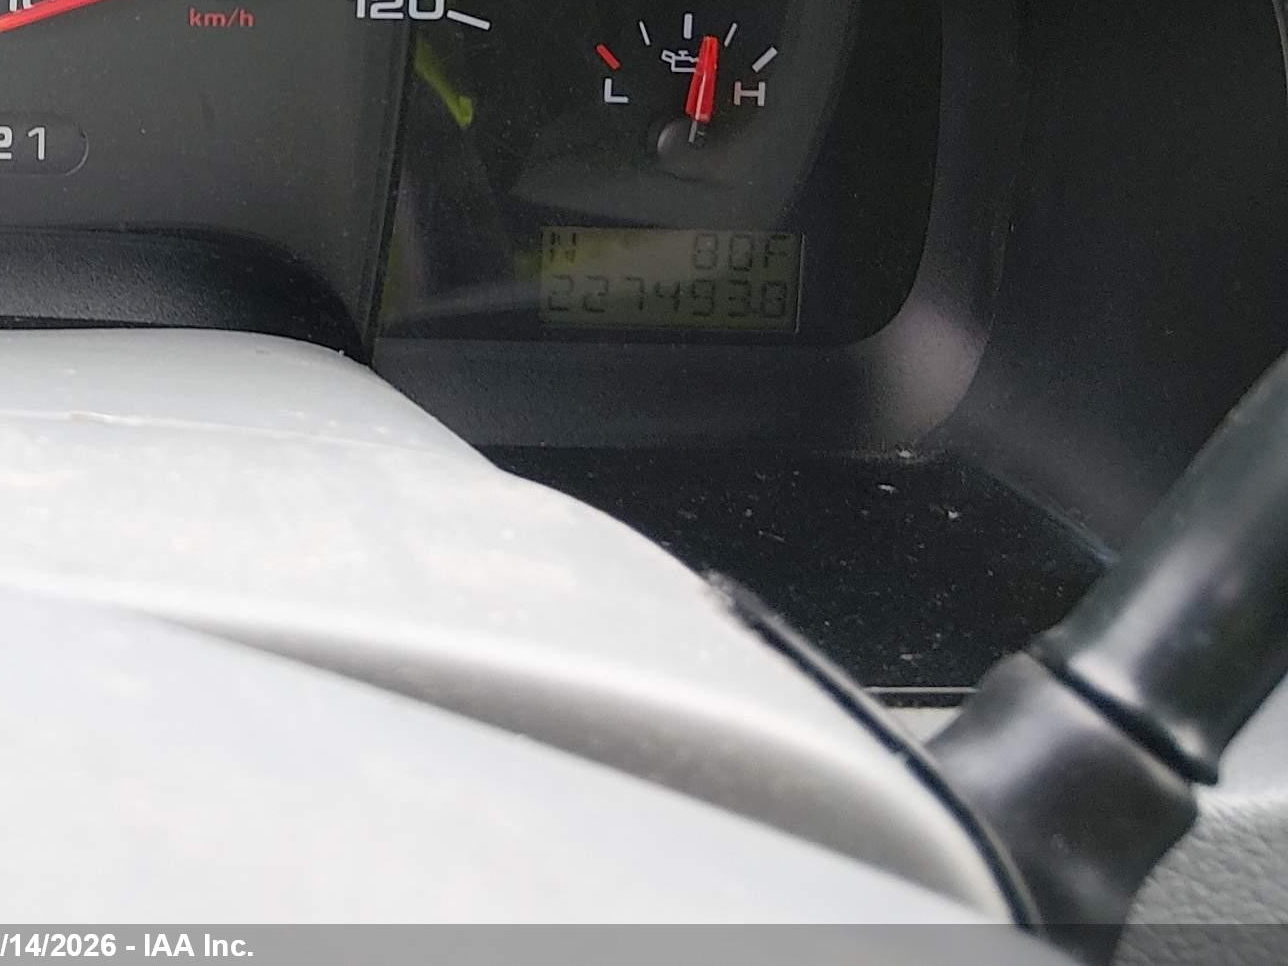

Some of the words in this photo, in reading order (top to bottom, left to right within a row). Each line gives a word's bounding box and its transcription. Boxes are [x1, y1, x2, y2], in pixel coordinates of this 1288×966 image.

[188, 10, 255, 27] km/h
[604, 79, 628, 103] L
[734, 82, 765, 106] H
